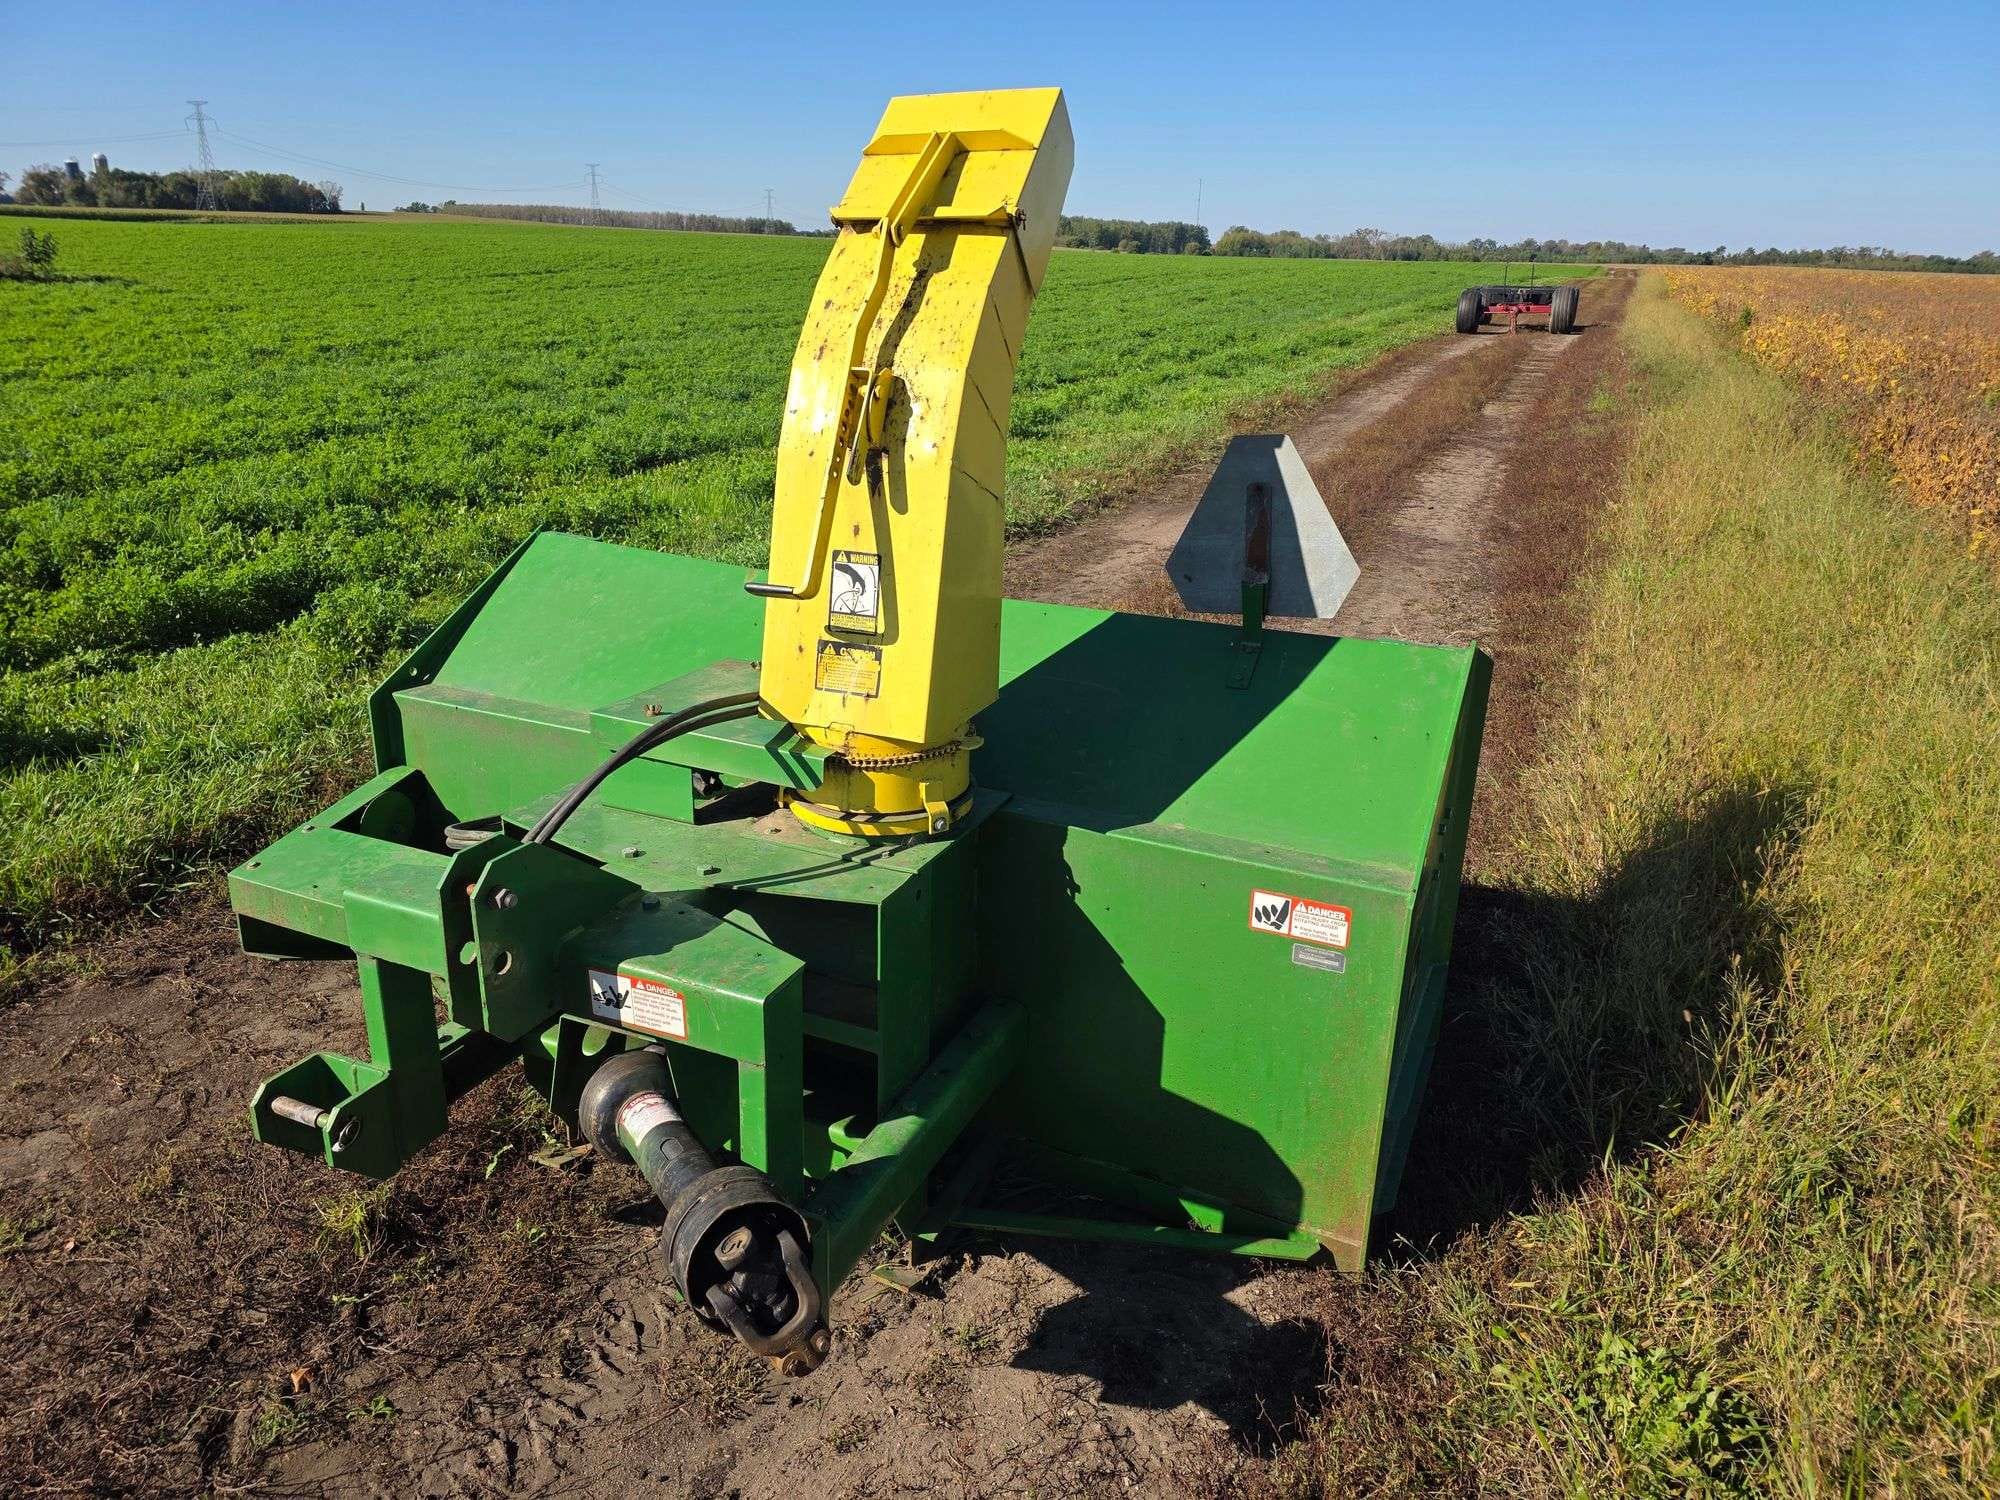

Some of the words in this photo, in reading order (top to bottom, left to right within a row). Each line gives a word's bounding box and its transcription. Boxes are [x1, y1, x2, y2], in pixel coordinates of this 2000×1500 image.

[850, 554, 878, 566] WARNING
[1307, 905, 1346, 921] DANGER
[645, 984, 678, 998] DANGER
